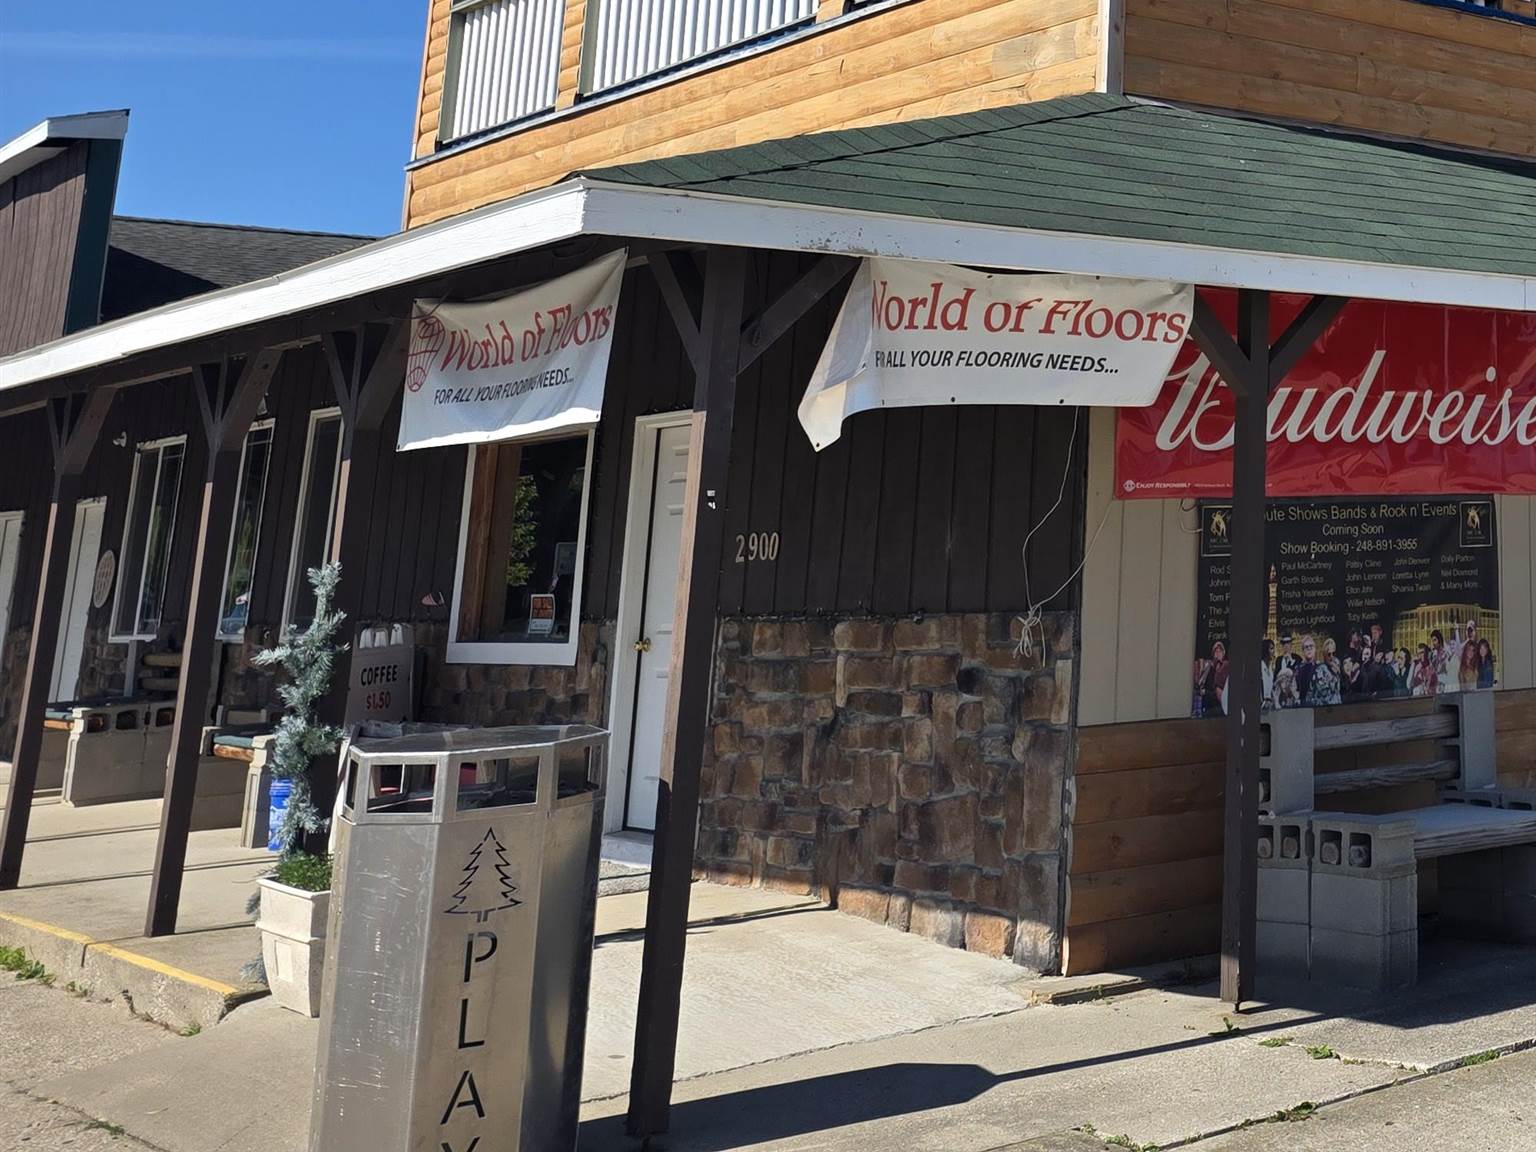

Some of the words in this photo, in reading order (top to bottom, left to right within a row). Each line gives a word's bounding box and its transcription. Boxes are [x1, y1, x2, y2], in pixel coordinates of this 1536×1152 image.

[983, 297, 1043, 334] of
[1039, 298, 1186, 345] Floors
[440, 319, 515, 372] World
[521, 311, 547, 363] of
[544, 303, 613, 356] Floors
[886, 350, 906, 368] ALL
[910, 349, 953, 369] YOUR
[955, 350, 1043, 370] FLOORING
[1043, 354, 1119, 375] NEEDS...
[433, 389, 454, 406] FOR
[453, 386, 472, 403] ALL
[475, 383, 503, 402] YOUR
[1287, 506, 1328, 521] Shows
[1331, 505, 1367, 520] Bands
[1369, 506, 1377, 518] &
[1379, 504, 1408, 518] Rock
[1422, 503, 1457, 517] Events
[1322, 523, 1359, 537] Coming
[1360, 522, 1385, 535] Soon
[735, 532, 779, 563] 2900
[1280, 541, 1308, 555] Show
[1311, 540, 1349, 556] Booking
[1281, 562, 1296, 571] Paul
[360, 664, 398, 686] COFFEE
[366, 691, 392, 710] $1.50
